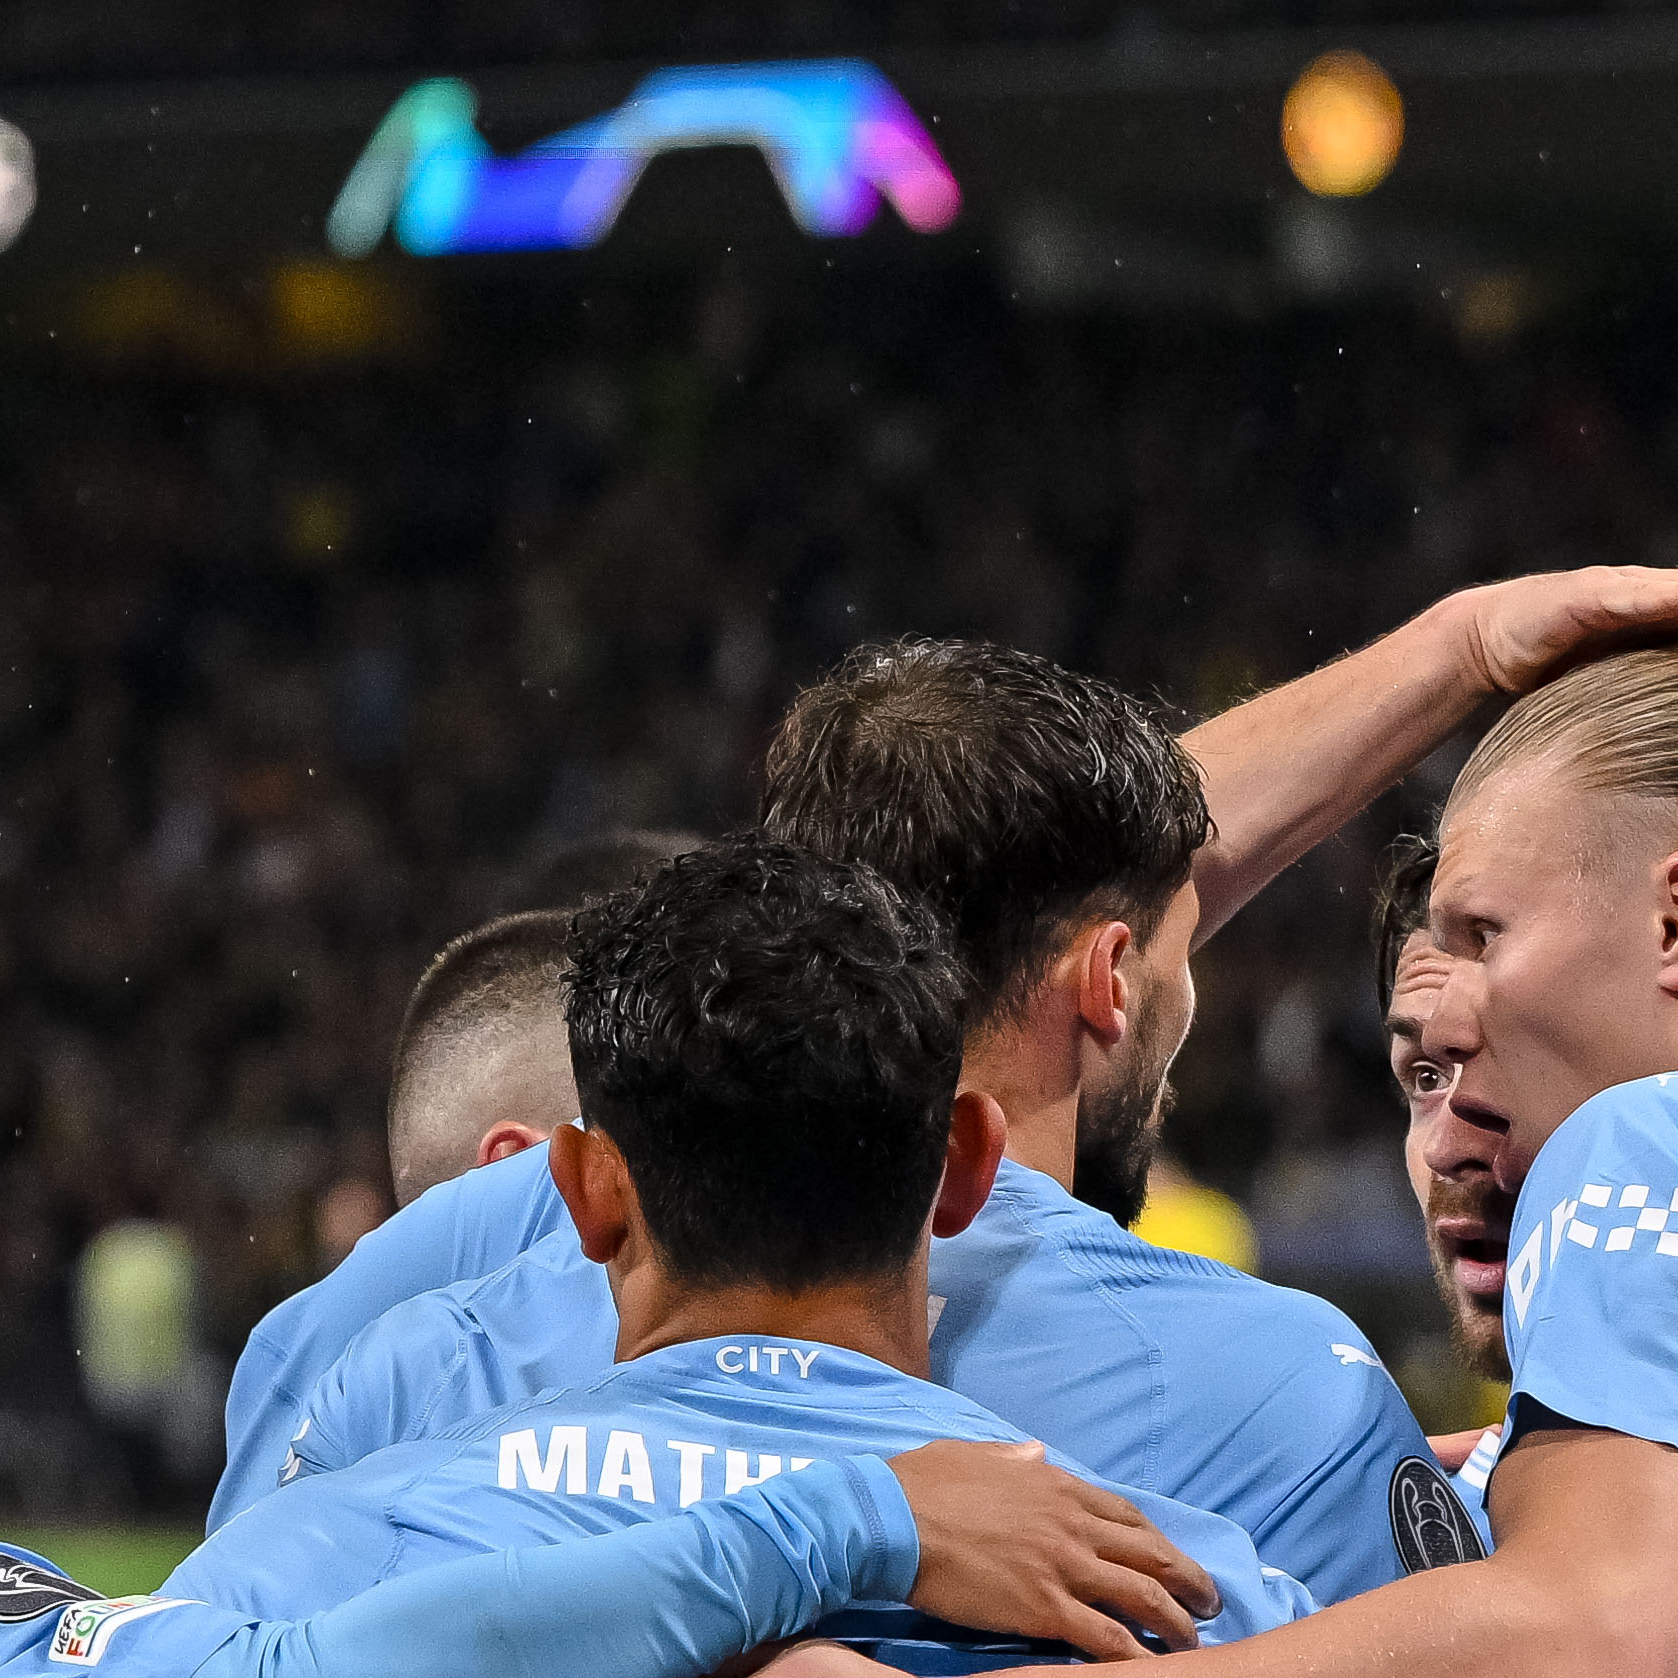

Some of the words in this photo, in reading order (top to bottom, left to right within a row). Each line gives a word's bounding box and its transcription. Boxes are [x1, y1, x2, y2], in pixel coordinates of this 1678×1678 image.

[715, 1345, 821, 1379] CITY
[496, 1425, 817, 1509] MATH
[54, 1608, 82, 1655] UEFA
